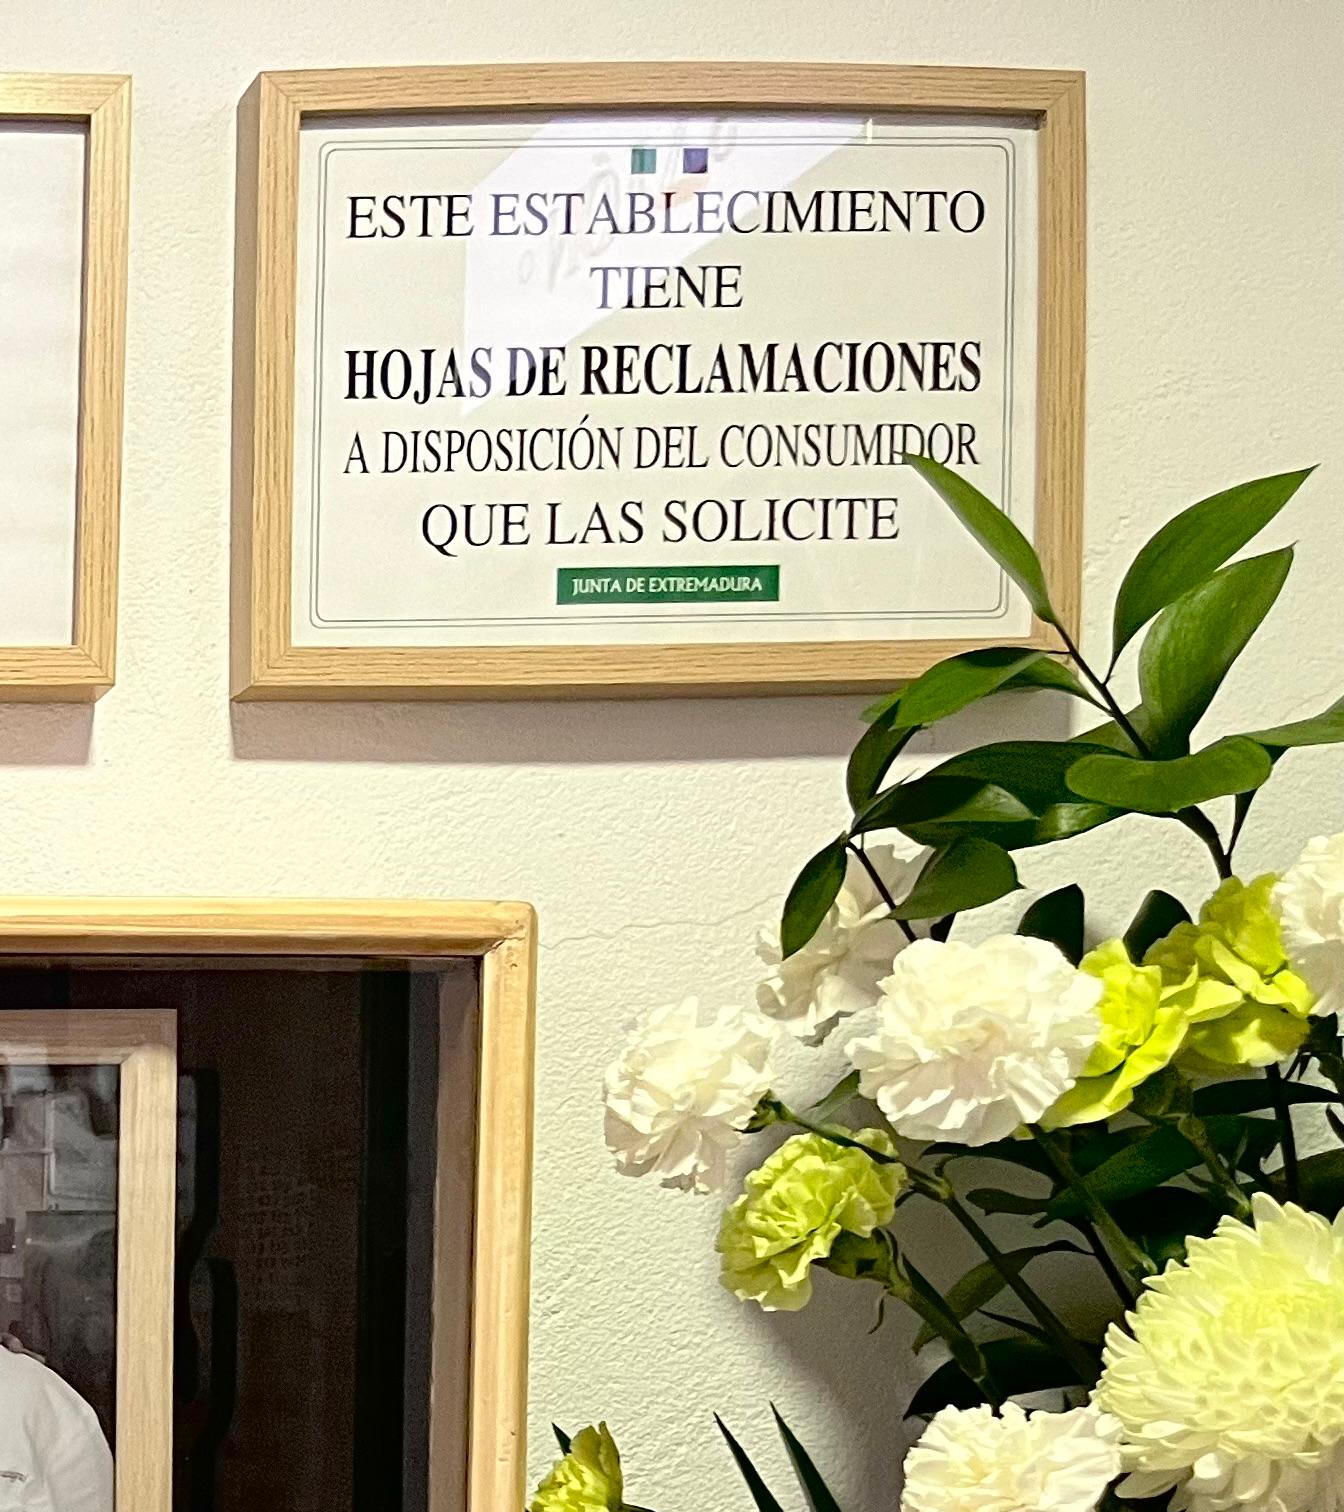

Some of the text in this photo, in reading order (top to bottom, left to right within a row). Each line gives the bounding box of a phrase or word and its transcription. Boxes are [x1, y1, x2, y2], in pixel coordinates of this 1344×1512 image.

[346, 190, 987, 240] ESTE ESTABLECIMIENTO
[590, 265, 744, 310] TIENE
[344, 341, 983, 406] HOJAS DE RECLAMACIONES
[343, 413, 982, 475] A DISPOSICIÓN DEL CONSUMIDOR
[421, 497, 901, 559] QUE LAS SOLICITE
[571, 577, 763, 596] JUNTA DE EXTREMADURA
